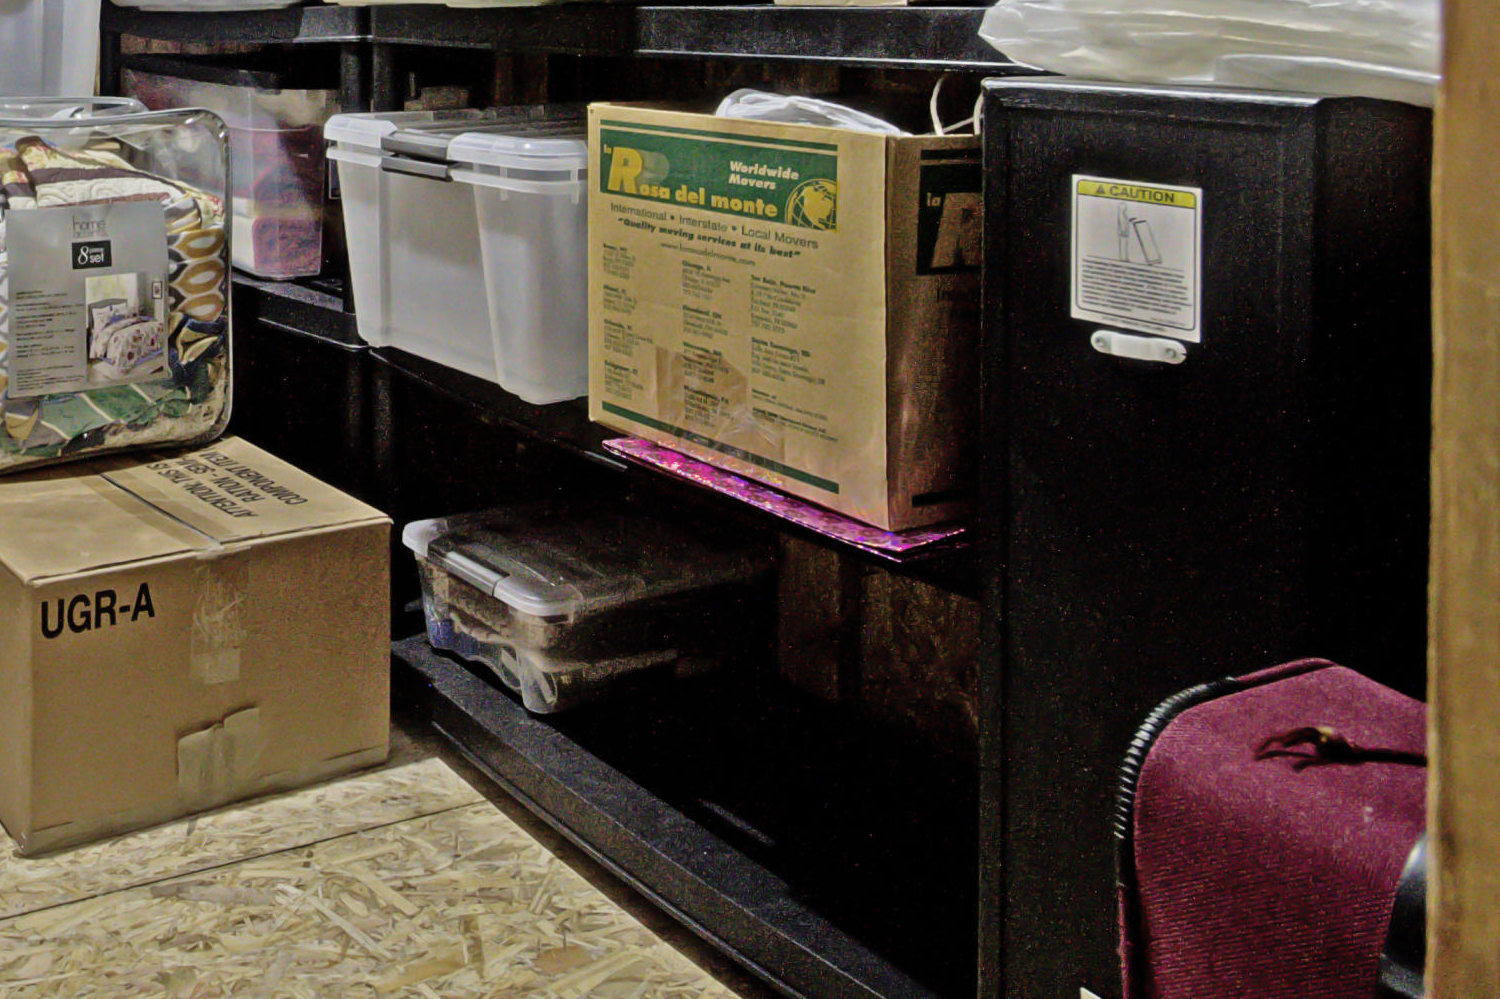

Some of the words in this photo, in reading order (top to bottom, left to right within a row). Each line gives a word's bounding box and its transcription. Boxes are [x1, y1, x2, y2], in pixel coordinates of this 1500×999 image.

[729, 160, 800, 181] Worldwide
[607, 147, 670, 199] Rosa
[674, 184, 706, 206] del
[711, 196, 779, 218] monte
[728, 173, 777, 191] Movers
[1109, 185, 1175, 203] CAUTION
[610, 202, 667, 222] International
[679, 215, 728, 233] Interstate
[741, 225, 771, 240] Local
[774, 226, 819, 250] Movers
[658, 227, 695, 242] moving
[696, 233, 737, 248] services
[739, 241, 751, 250] at
[78, 245, 89, 265] 8
[90, 252, 105, 263] set
[146, 462, 169, 471] IS
[199, 451, 239, 470] ITEM
[157, 469, 193, 484] THIS
[225, 462, 308, 505] COMPONENT
[211, 476, 267, 502] RATION
[41, 582, 155, 639] UGR-A
